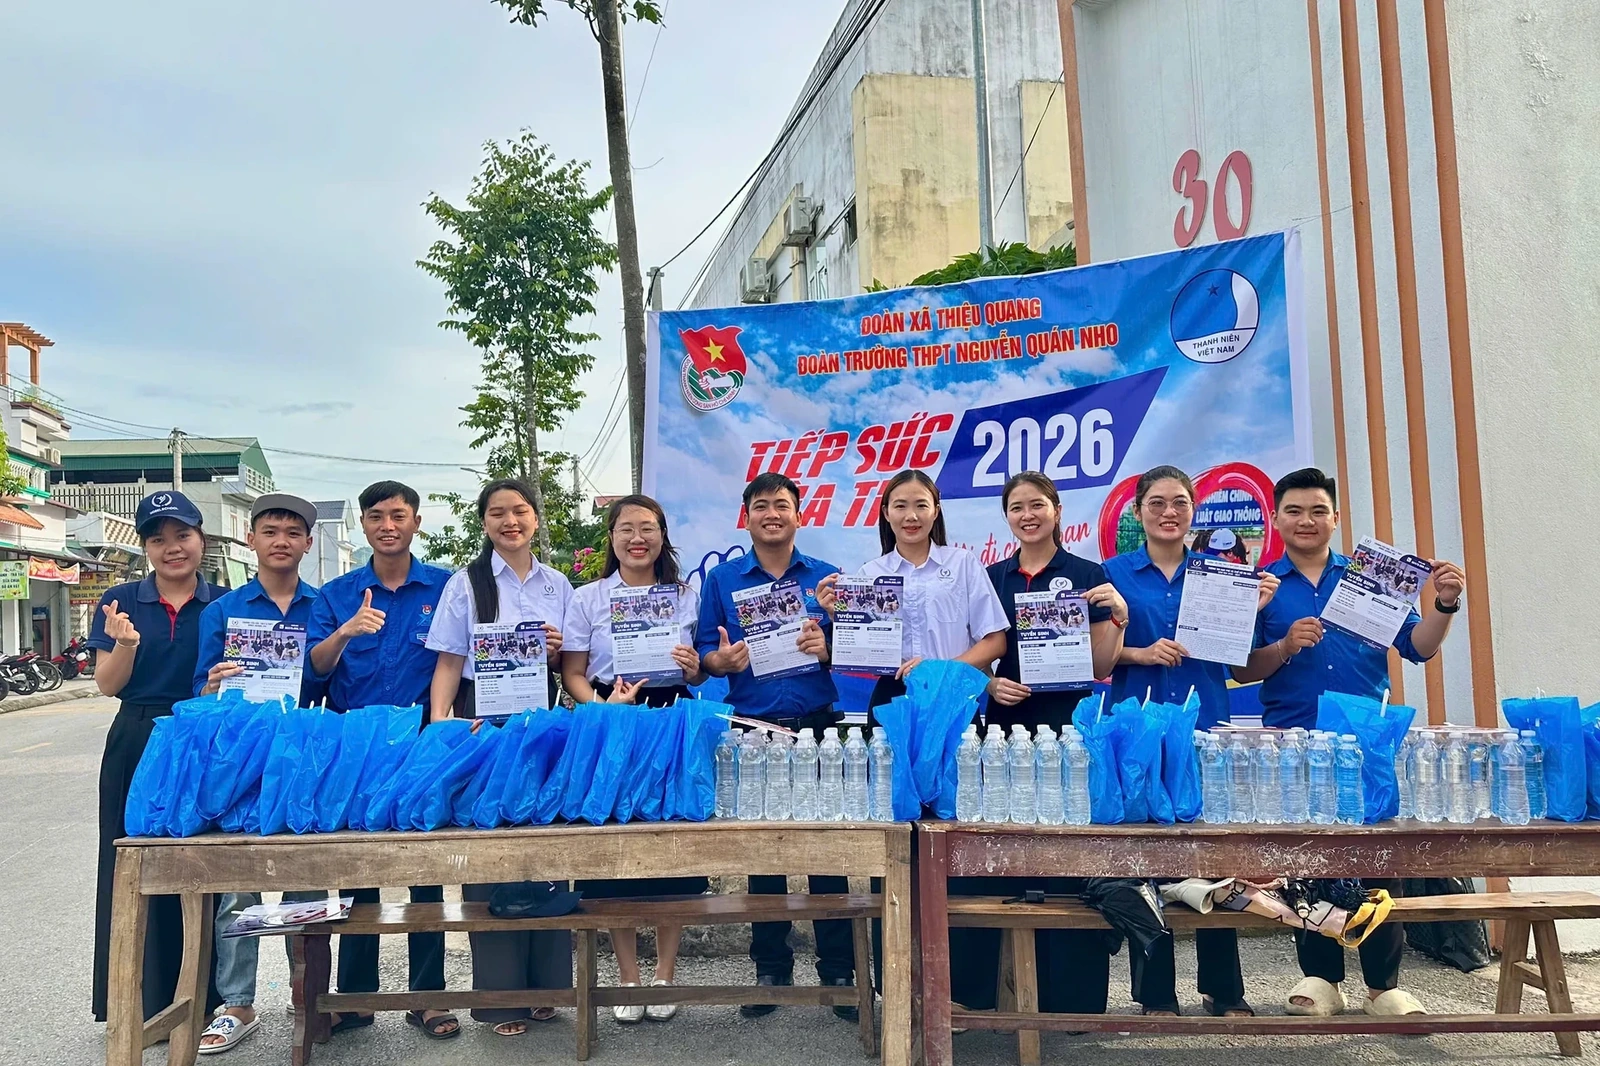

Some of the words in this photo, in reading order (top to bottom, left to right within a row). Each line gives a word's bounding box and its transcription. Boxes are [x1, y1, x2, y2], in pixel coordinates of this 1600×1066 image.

[1172, 149, 1252, 248] 30
[861, 309, 905, 335] ĐOÀN
[909, 306, 932, 332] XÃ
[936, 301, 981, 332] THIỆU
[984, 297, 1042, 326] QUANG
[797, 351, 840, 376] ĐOÀN
[844, 345, 908, 372] TRƯỜNG
[912, 343, 951, 367] THPT
[955, 329, 1023, 364] NGUYỄN
[1025, 325, 1075, 358] QUÁN
[1079, 322, 1119, 350] NHO
[1193, 337, 1219, 349] THANH
[1220, 334, 1240, 343] NIÊN
[1216, 345, 1235, 354] NAM
[745, 428, 850, 484] TIẾP
[853, 411, 954, 476] SỨC
[972, 408, 1114, 488] 2026
[1213, 509, 1233, 523] GIAO
[1233, 505, 1261, 522] THÔNG
